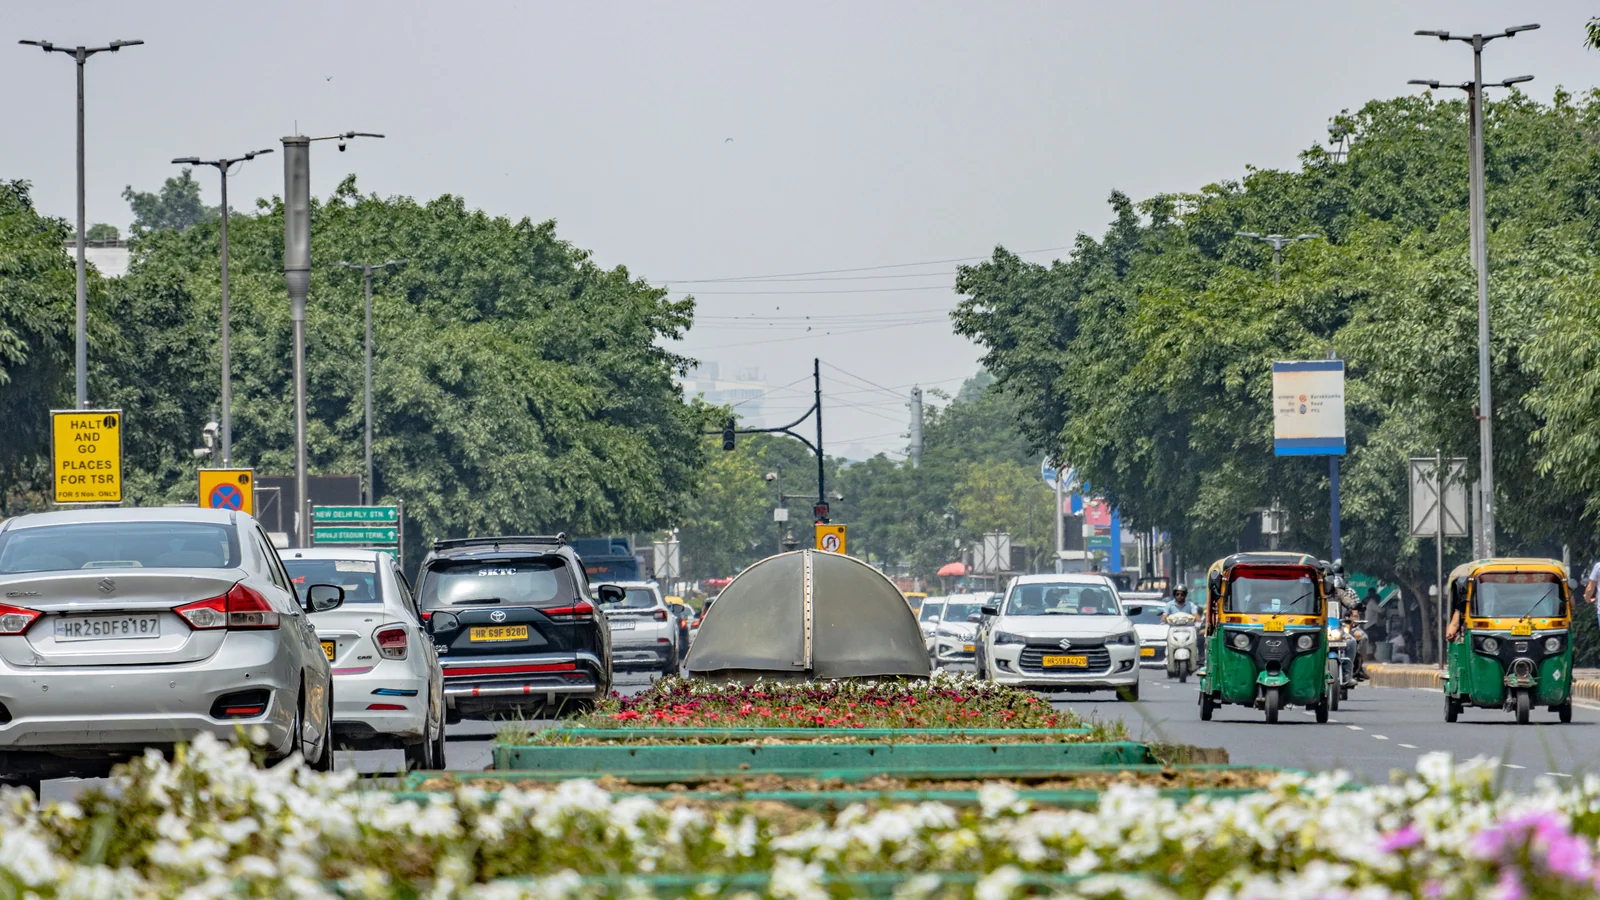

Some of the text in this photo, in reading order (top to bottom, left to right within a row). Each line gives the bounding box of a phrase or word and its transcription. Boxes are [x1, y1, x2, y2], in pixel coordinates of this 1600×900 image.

[70, 420, 102, 430] HALT
[74, 432, 100, 442] AND
[78, 444, 96, 454] GO
[62, 460, 112, 470] PLACES
[60, 474, 114, 485] FOR TSR
[339, 531, 364, 539] STADIUM
[478, 567, 517, 577] SKTC
[64, 618, 157, 637] HR26DF8187
[475, 627, 527, 638] HR 69F 9280
